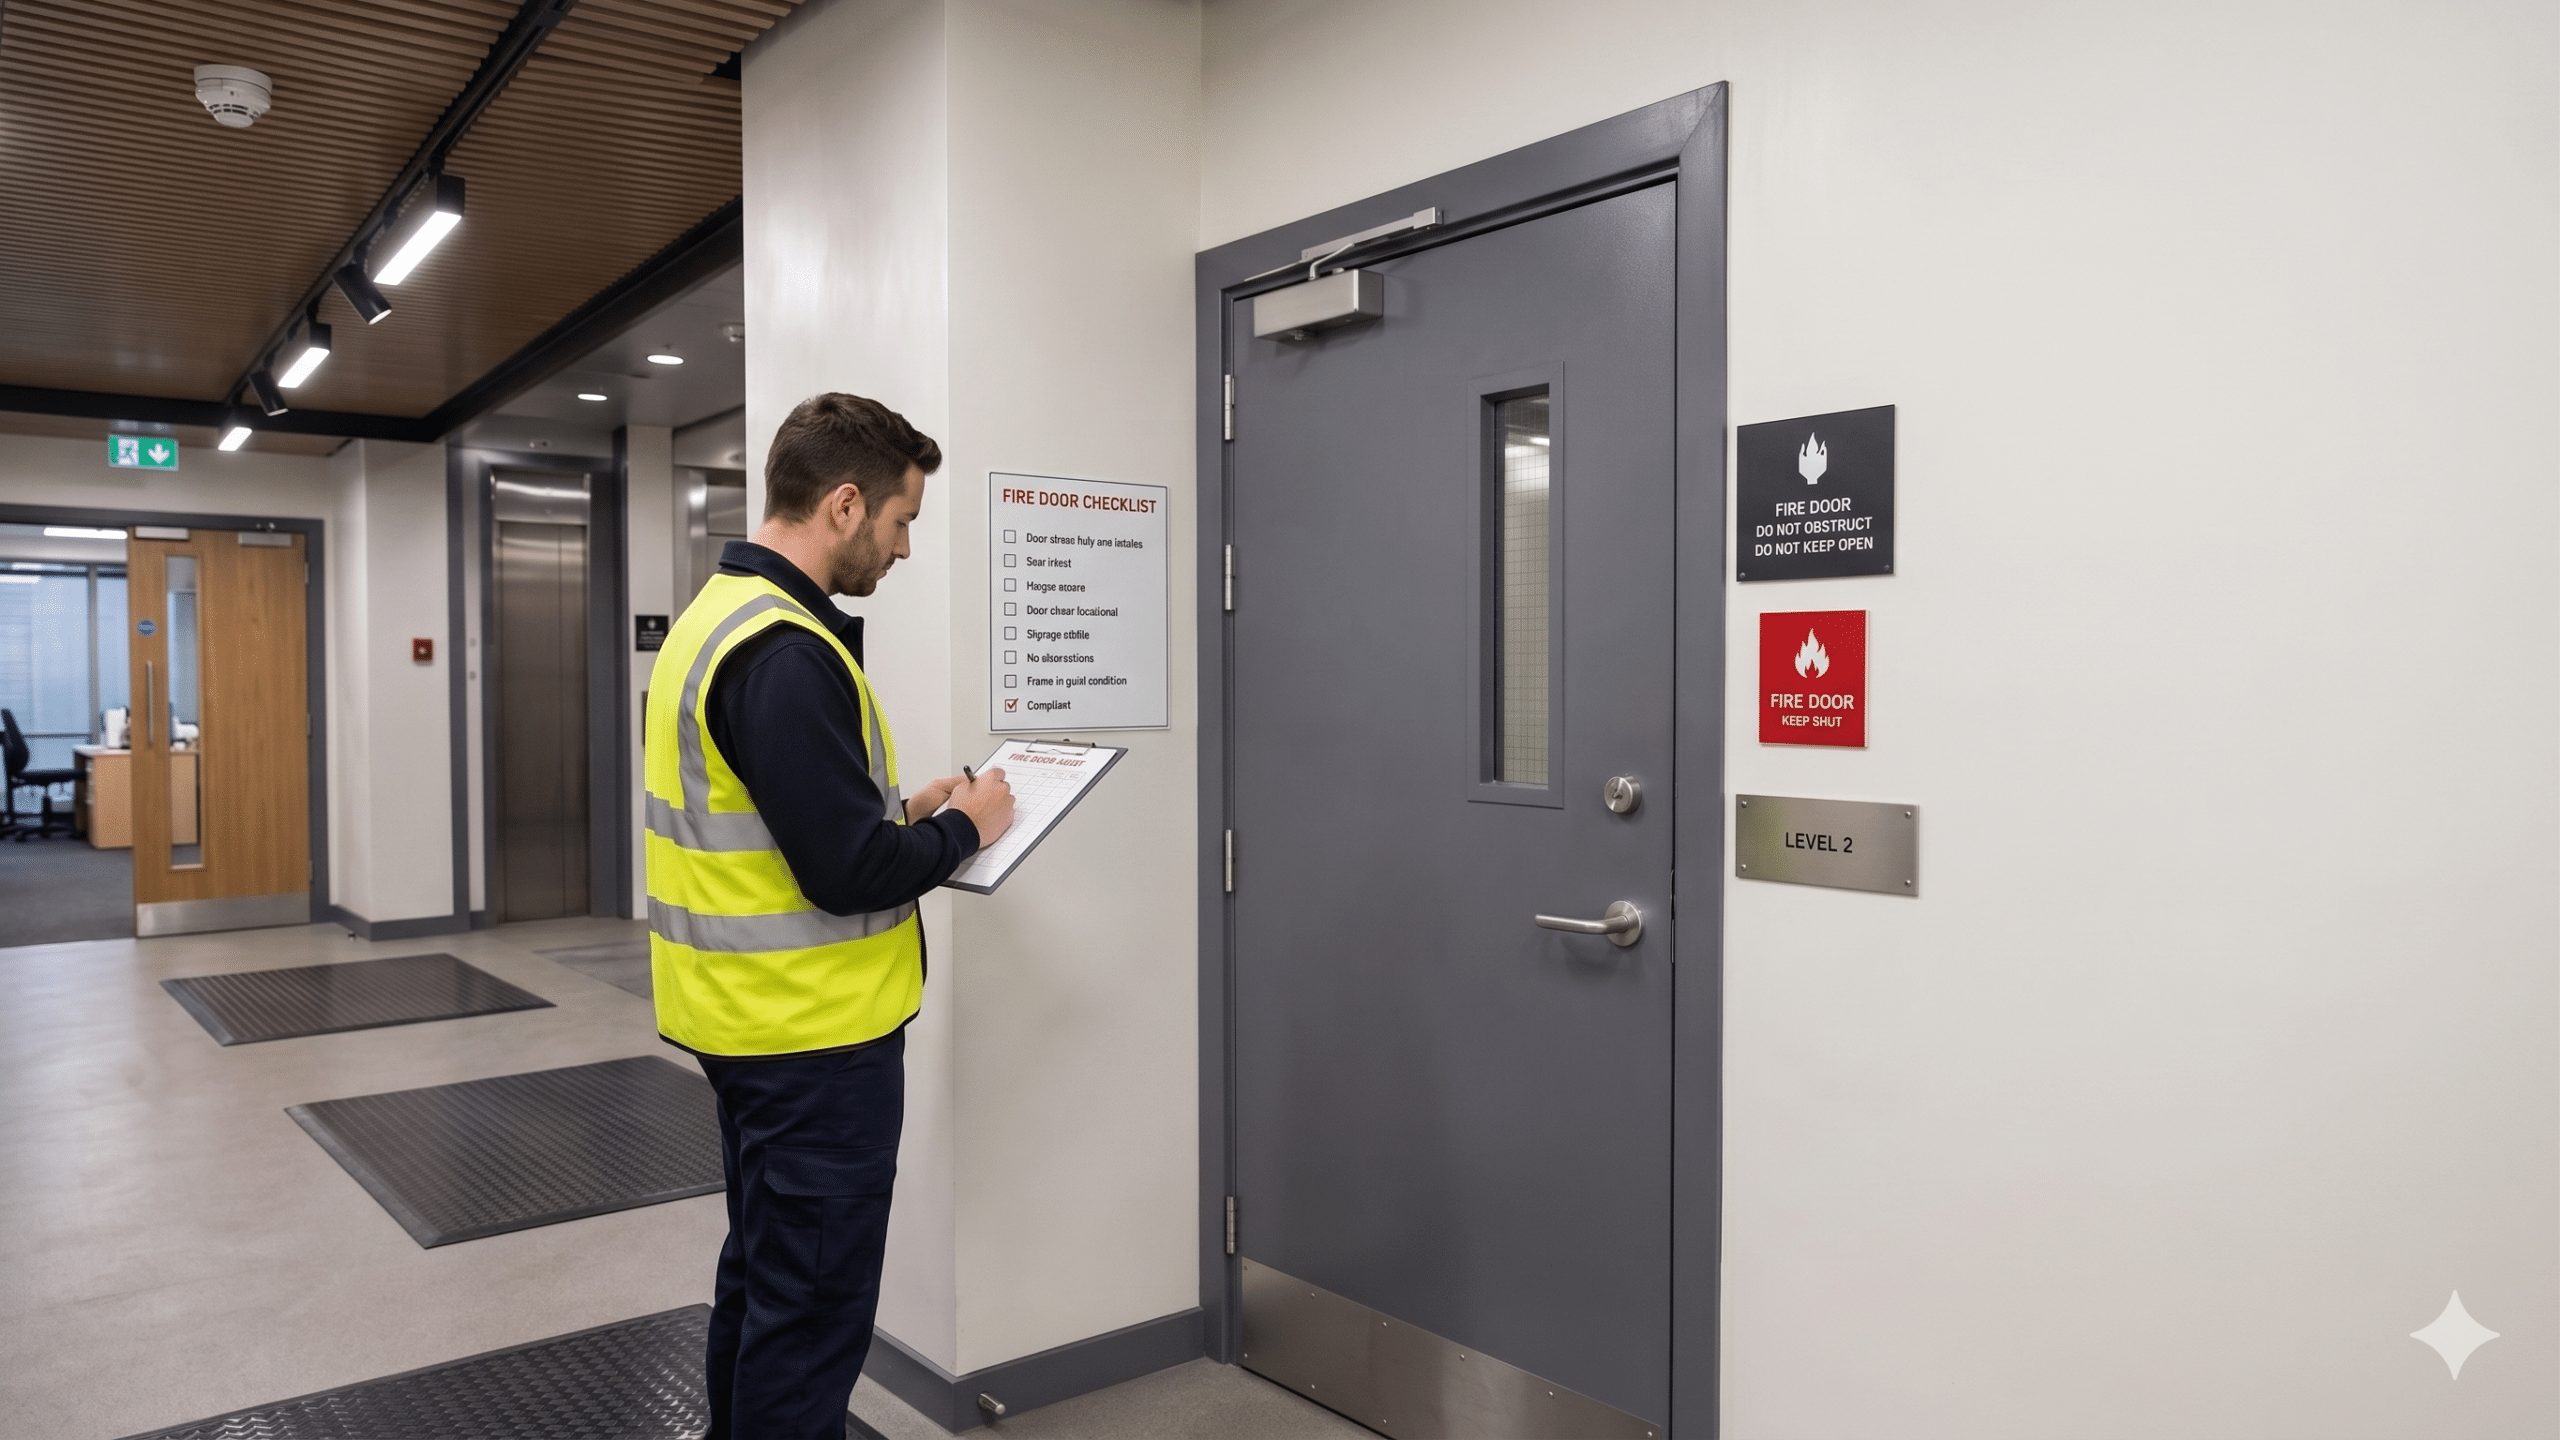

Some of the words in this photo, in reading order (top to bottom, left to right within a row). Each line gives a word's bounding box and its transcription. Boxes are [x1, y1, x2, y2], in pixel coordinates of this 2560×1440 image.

[1003, 488, 1035, 505] FIRE
[1039, 491, 1079, 508] DOOR
[1083, 494, 1157, 513] CHECKLIST
[1775, 501, 1806, 517] FIRE
[1809, 497, 1851, 514] DOOR
[1756, 524, 1774, 537] DO
[1776, 522, 1801, 536] NOT
[1804, 516, 1873, 534] OBSTRUCT
[1026, 532, 1048, 544] Door
[1755, 543, 1773, 557] DO
[1775, 541, 1800, 555] NOT
[1803, 539, 1835, 554] KEEP
[1838, 536, 1873, 551] OPEN
[1026, 605, 1048, 615] Door
[1026, 653, 1040, 663] No
[1027, 676, 1054, 686] Frame
[1055, 675, 1064, 686] in
[1770, 693, 1804, 709] FIRE
[1808, 693, 1854, 710] DOOR
[1781, 715, 1810, 727] KEEP
[1812, 715, 1843, 728] SHUT
[1785, 832, 1838, 852] LEVEL
[1843, 836, 1853, 853] 2
